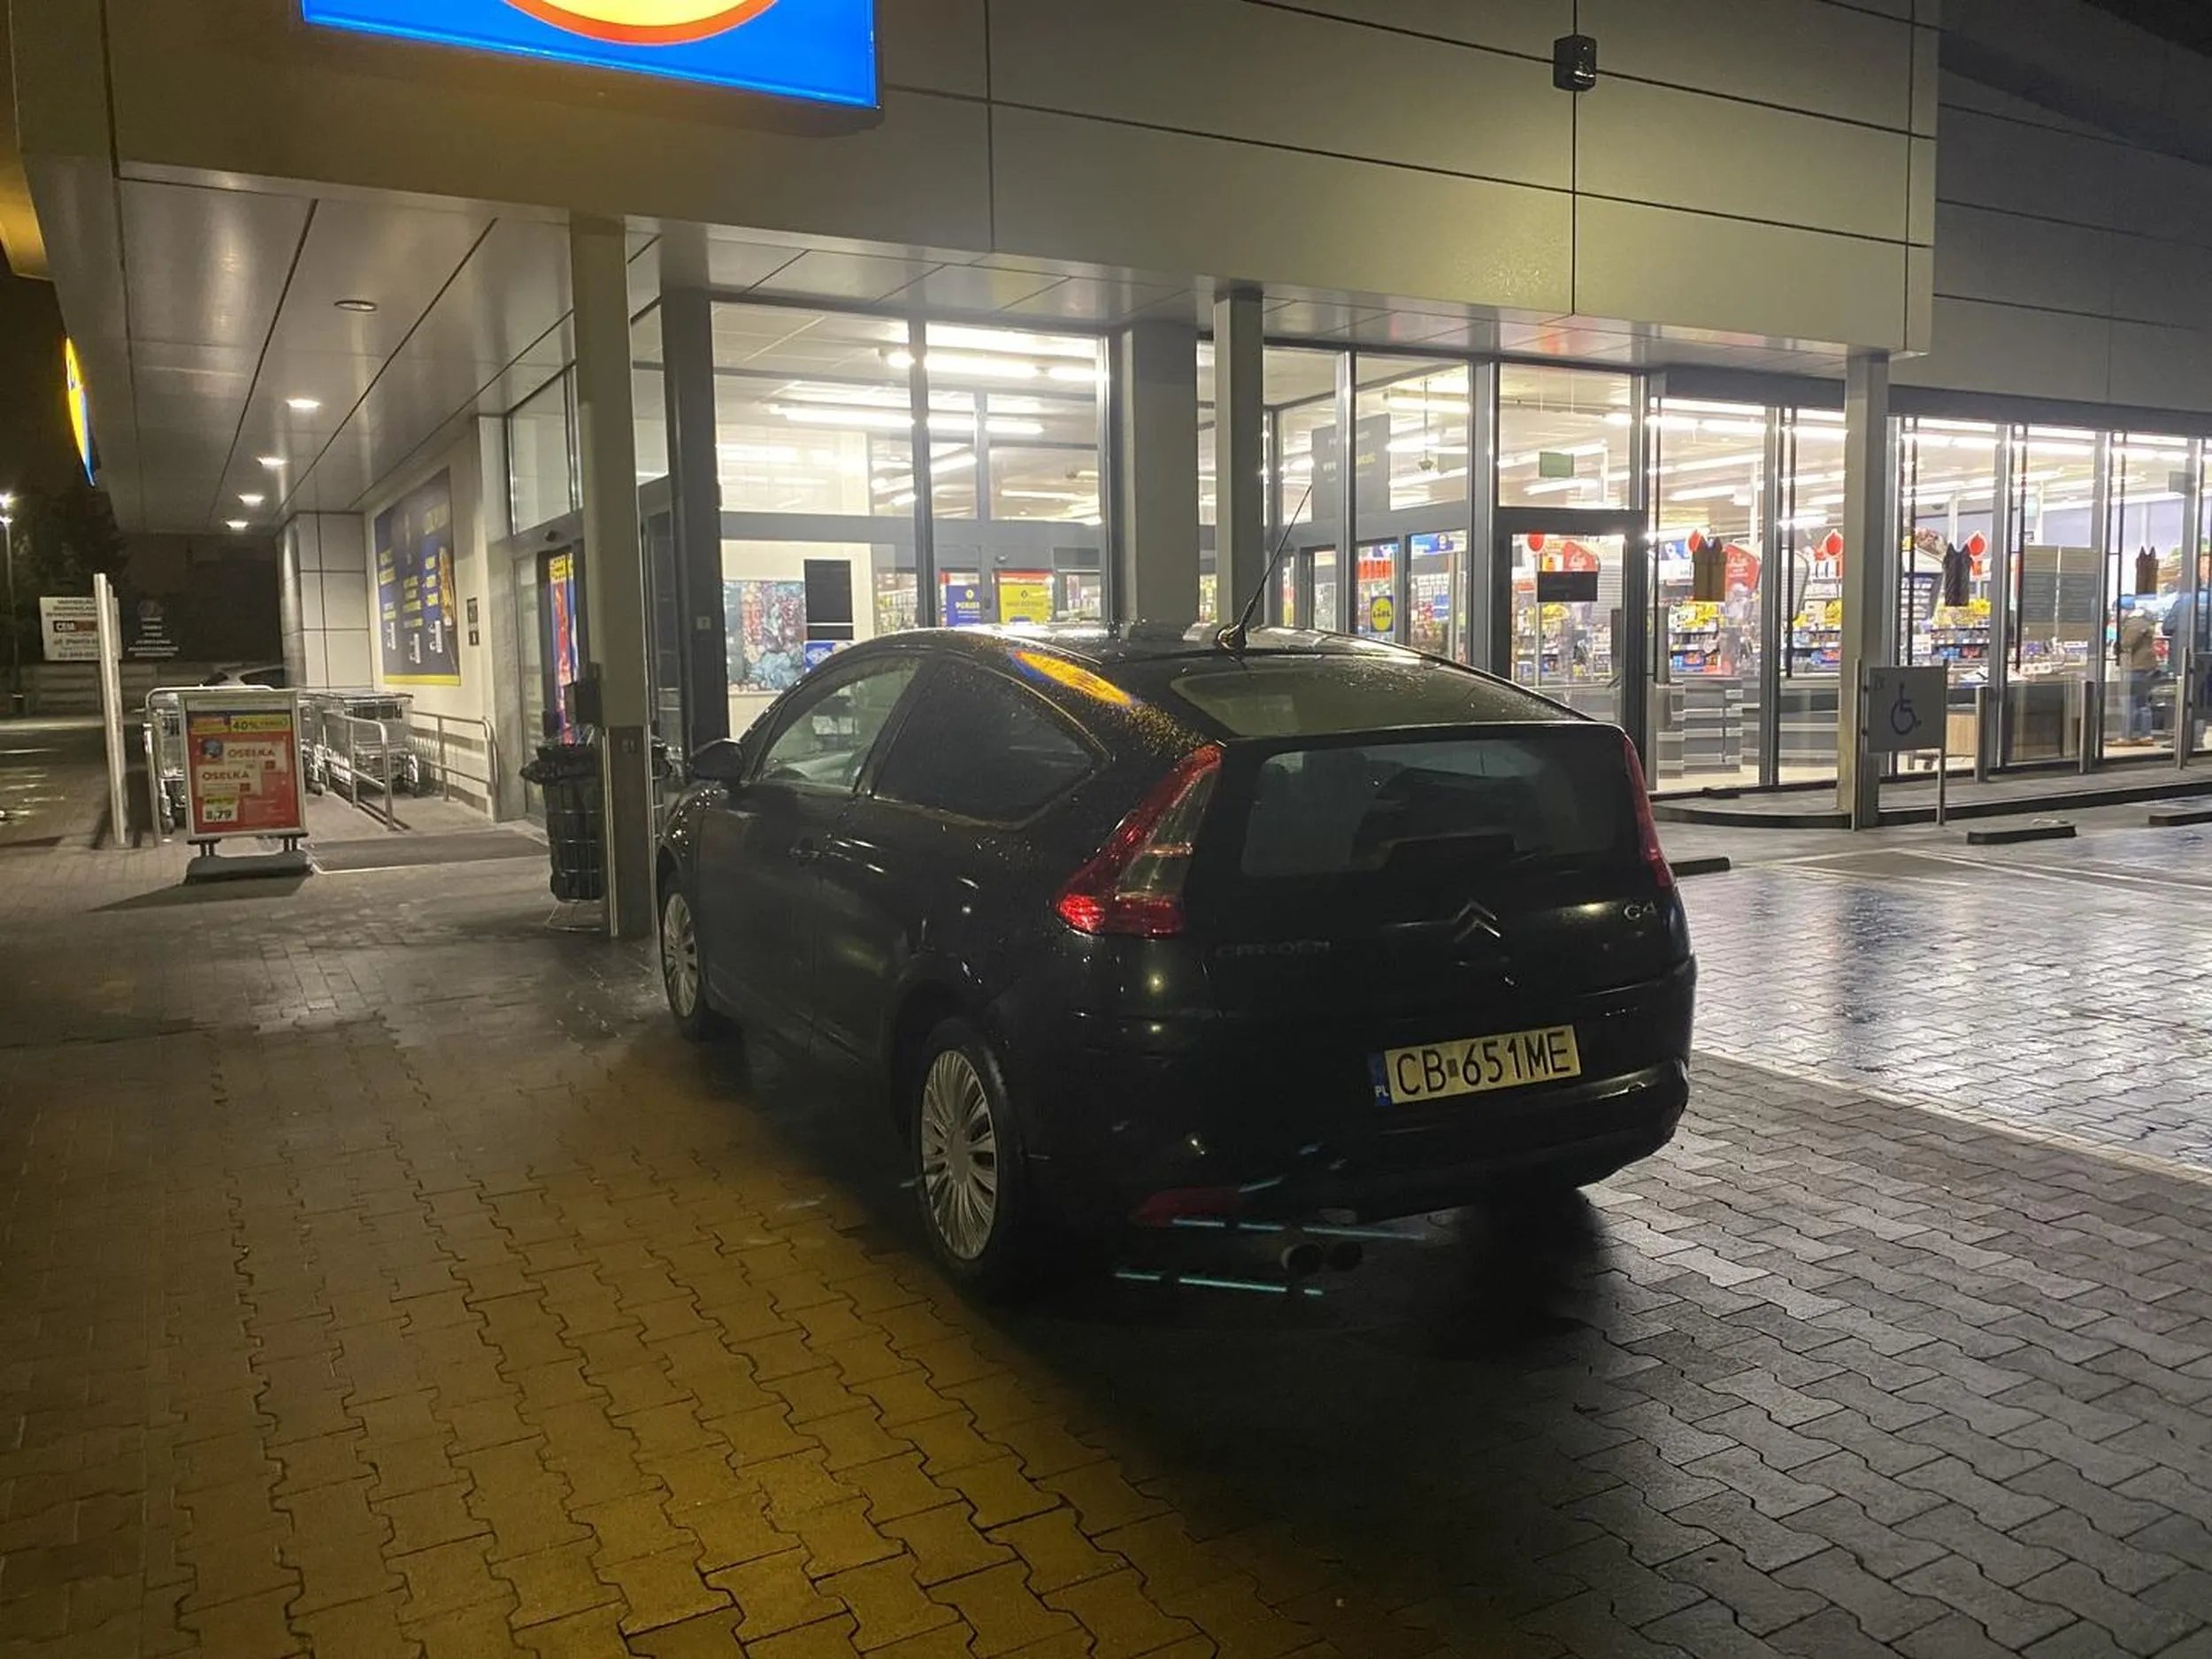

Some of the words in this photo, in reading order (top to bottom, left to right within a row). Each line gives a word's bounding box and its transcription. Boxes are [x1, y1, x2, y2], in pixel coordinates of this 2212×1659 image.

[1624, 900, 1657, 921] C4
[1395, 1049, 1448, 1095] CB
[1462, 1031, 1571, 1087] 651ME
[1375, 1086, 1389, 1098] PL
